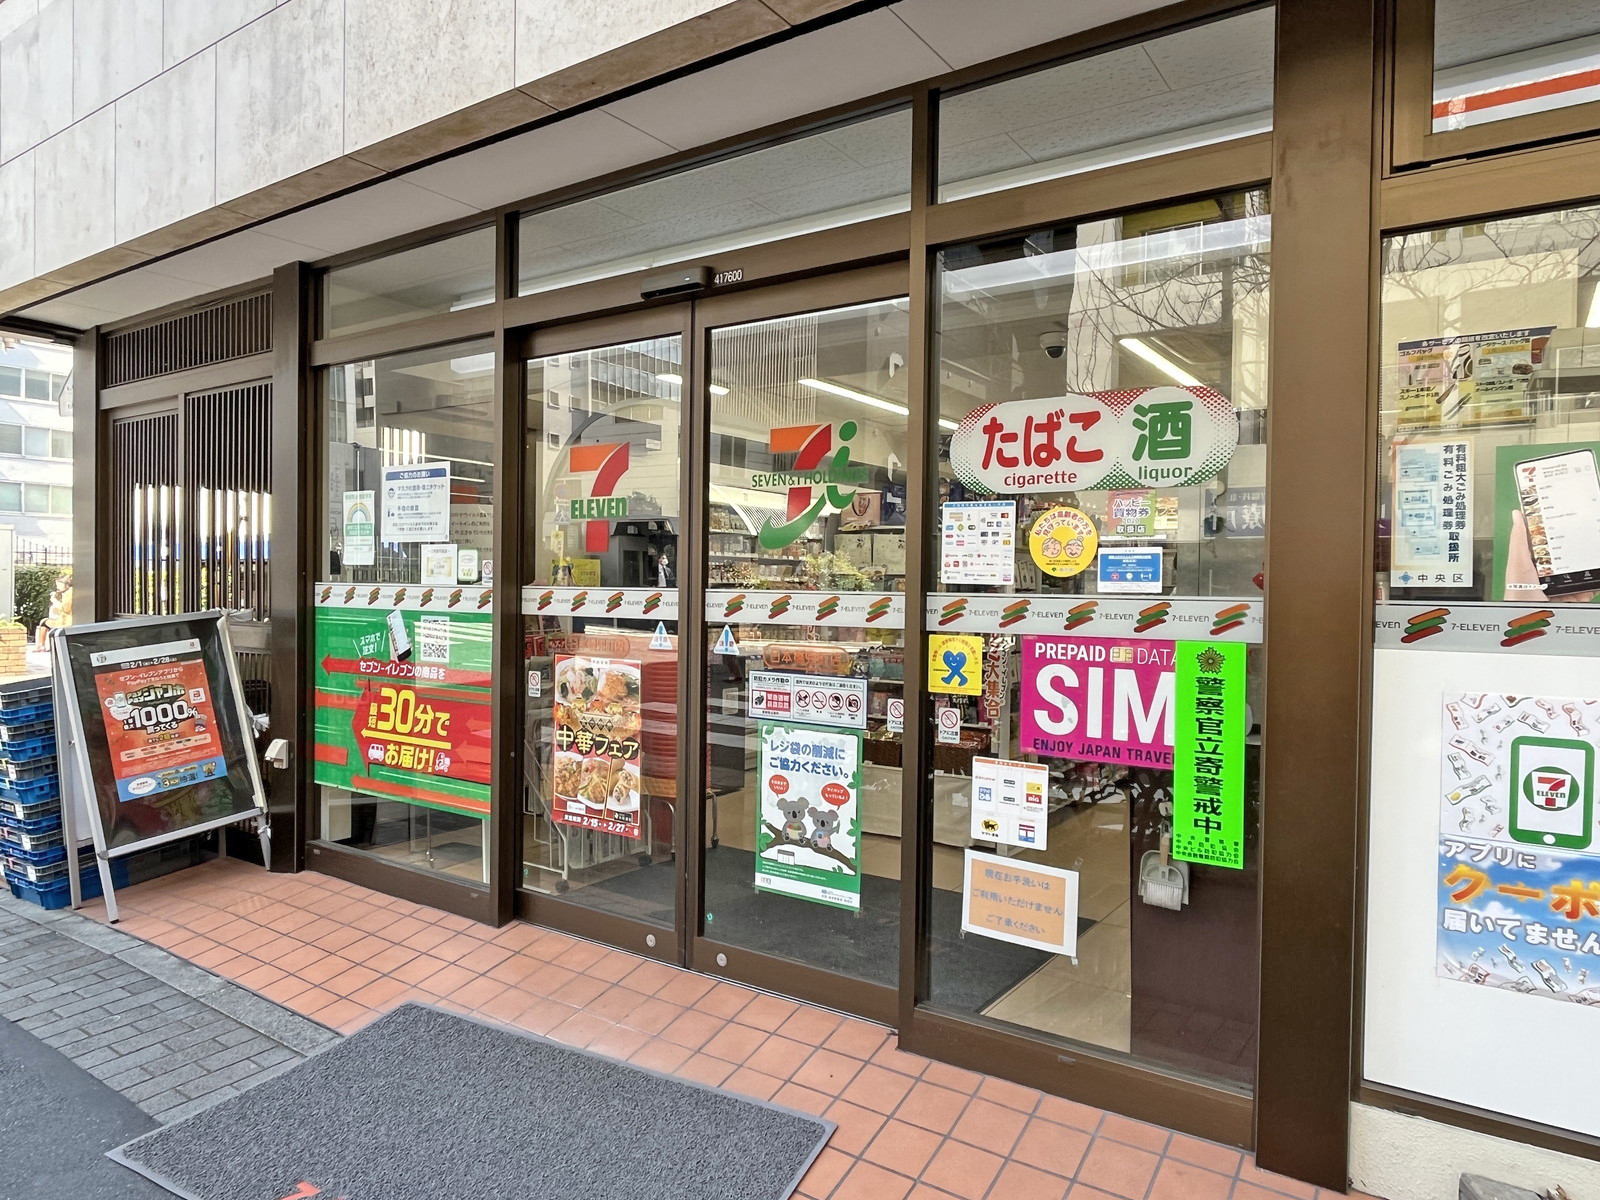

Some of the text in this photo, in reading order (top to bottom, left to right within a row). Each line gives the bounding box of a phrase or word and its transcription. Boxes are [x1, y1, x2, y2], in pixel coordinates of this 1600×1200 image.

[714, 269, 743, 284] 417600
[982, 408, 1104, 470] たばこ
[1132, 400, 1194, 462] 酒
[1004, 470, 1078, 488] cigarette
[1138, 465, 1193, 483] liquor
[1442, 444, 1454, 530] 有料ごみ処理券
[1455, 444, 1467, 530] 有料粗大ごみ処理券
[1116, 525, 1146, 534] 取扱店
[1448, 532, 1460, 562] 取扱所
[1417, 573, 1463, 583] 中央区
[1035, 642, 1106, 662] PREPAID
[359, 660, 446, 680] セブン-イレブンの商品を
[377, 687, 451, 737] 30分で
[1033, 663, 1175, 747] SIM
[556, 725, 639, 760] 中華フェア
[770, 740, 845, 760] レジ袋の削減に
[1033, 738, 1074, 753] ENJOY
[1078, 743, 1121, 759] JAPAN
[1193, 676, 1226, 835] 警察官立寄警戒中
[385, 743, 435, 773] お届け!
[769, 756, 849, 779] ご協力ください。
[1444, 840, 1537, 870] アプリに
[971, 888, 1064, 917] ご利用いただけません
[1443, 908, 1600, 957] 届いてません
